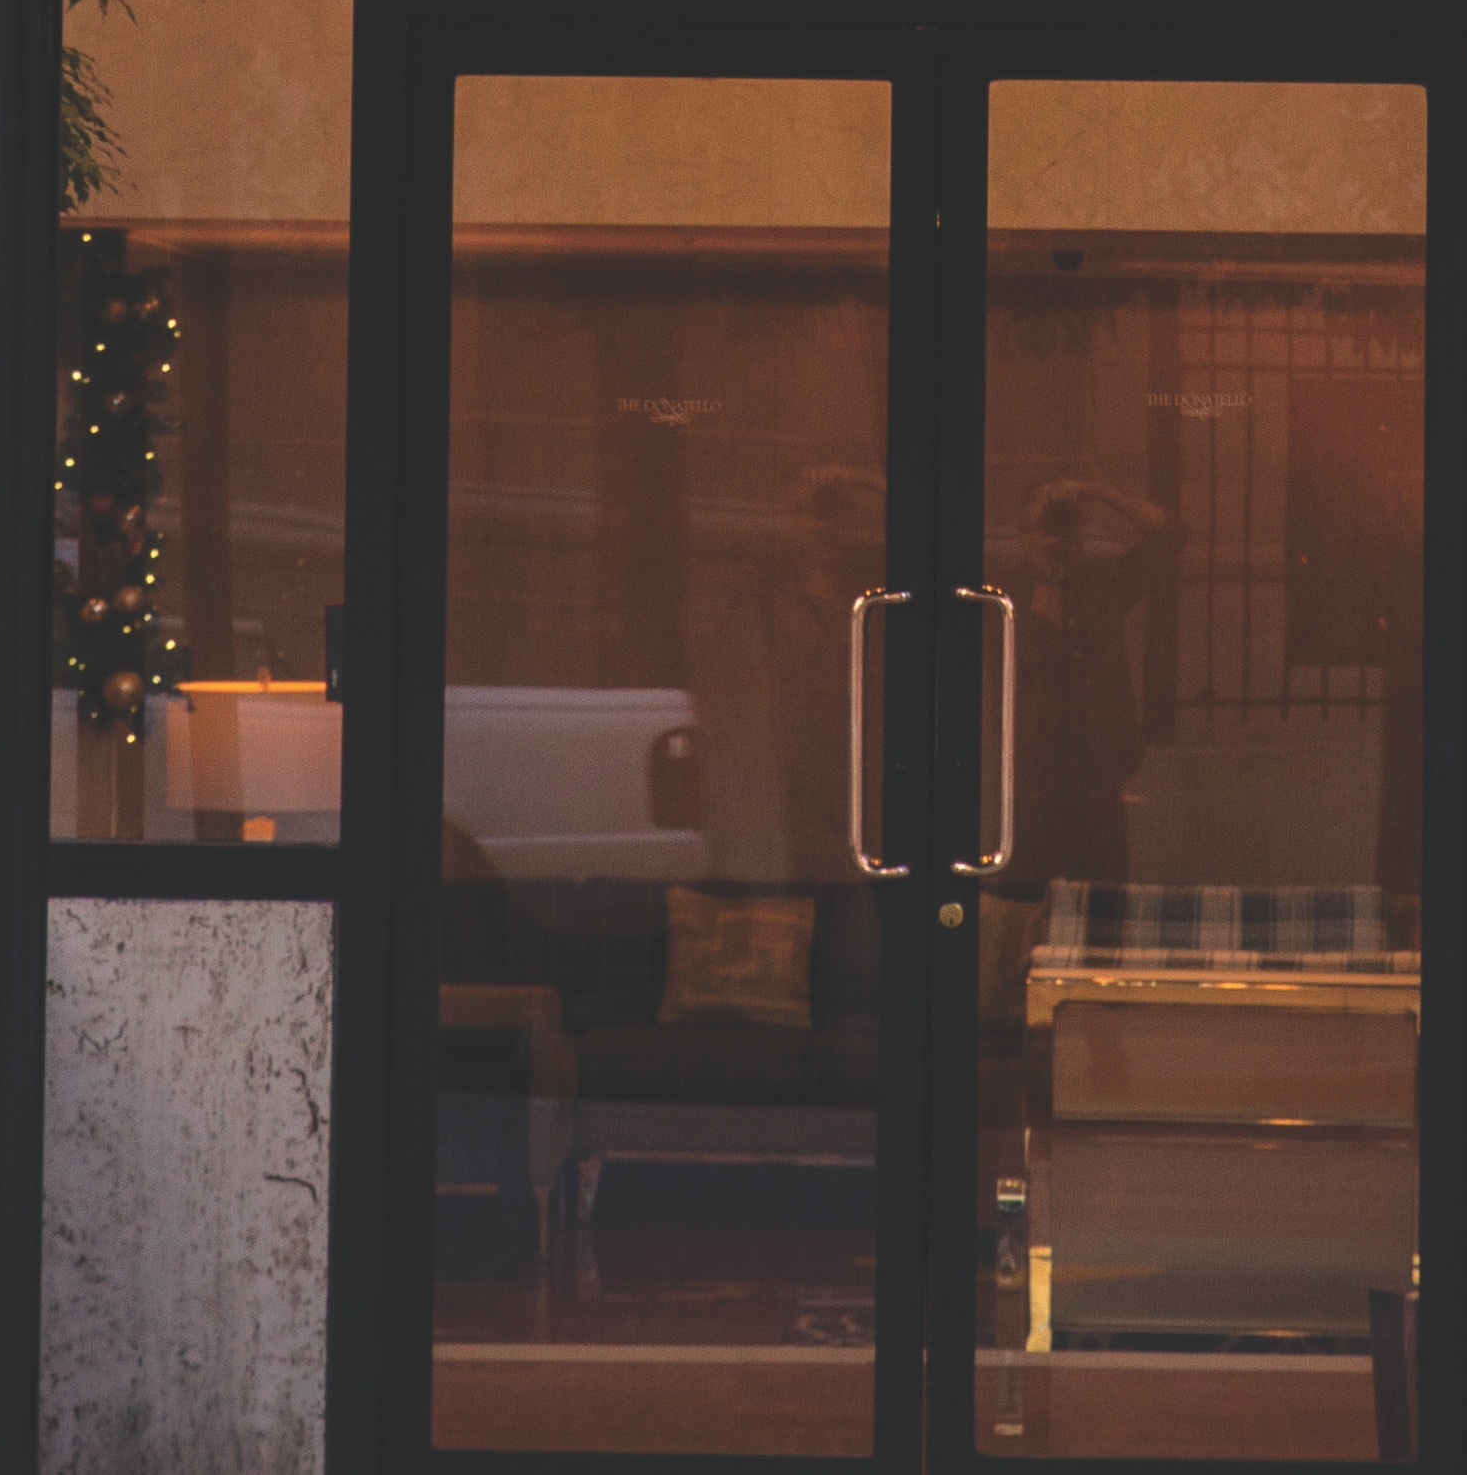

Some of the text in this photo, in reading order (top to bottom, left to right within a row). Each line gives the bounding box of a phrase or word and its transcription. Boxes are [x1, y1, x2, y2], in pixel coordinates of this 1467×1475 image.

[616, 396, 722, 413] THE DONATELLO
[1144, 392, 1170, 407] THE
